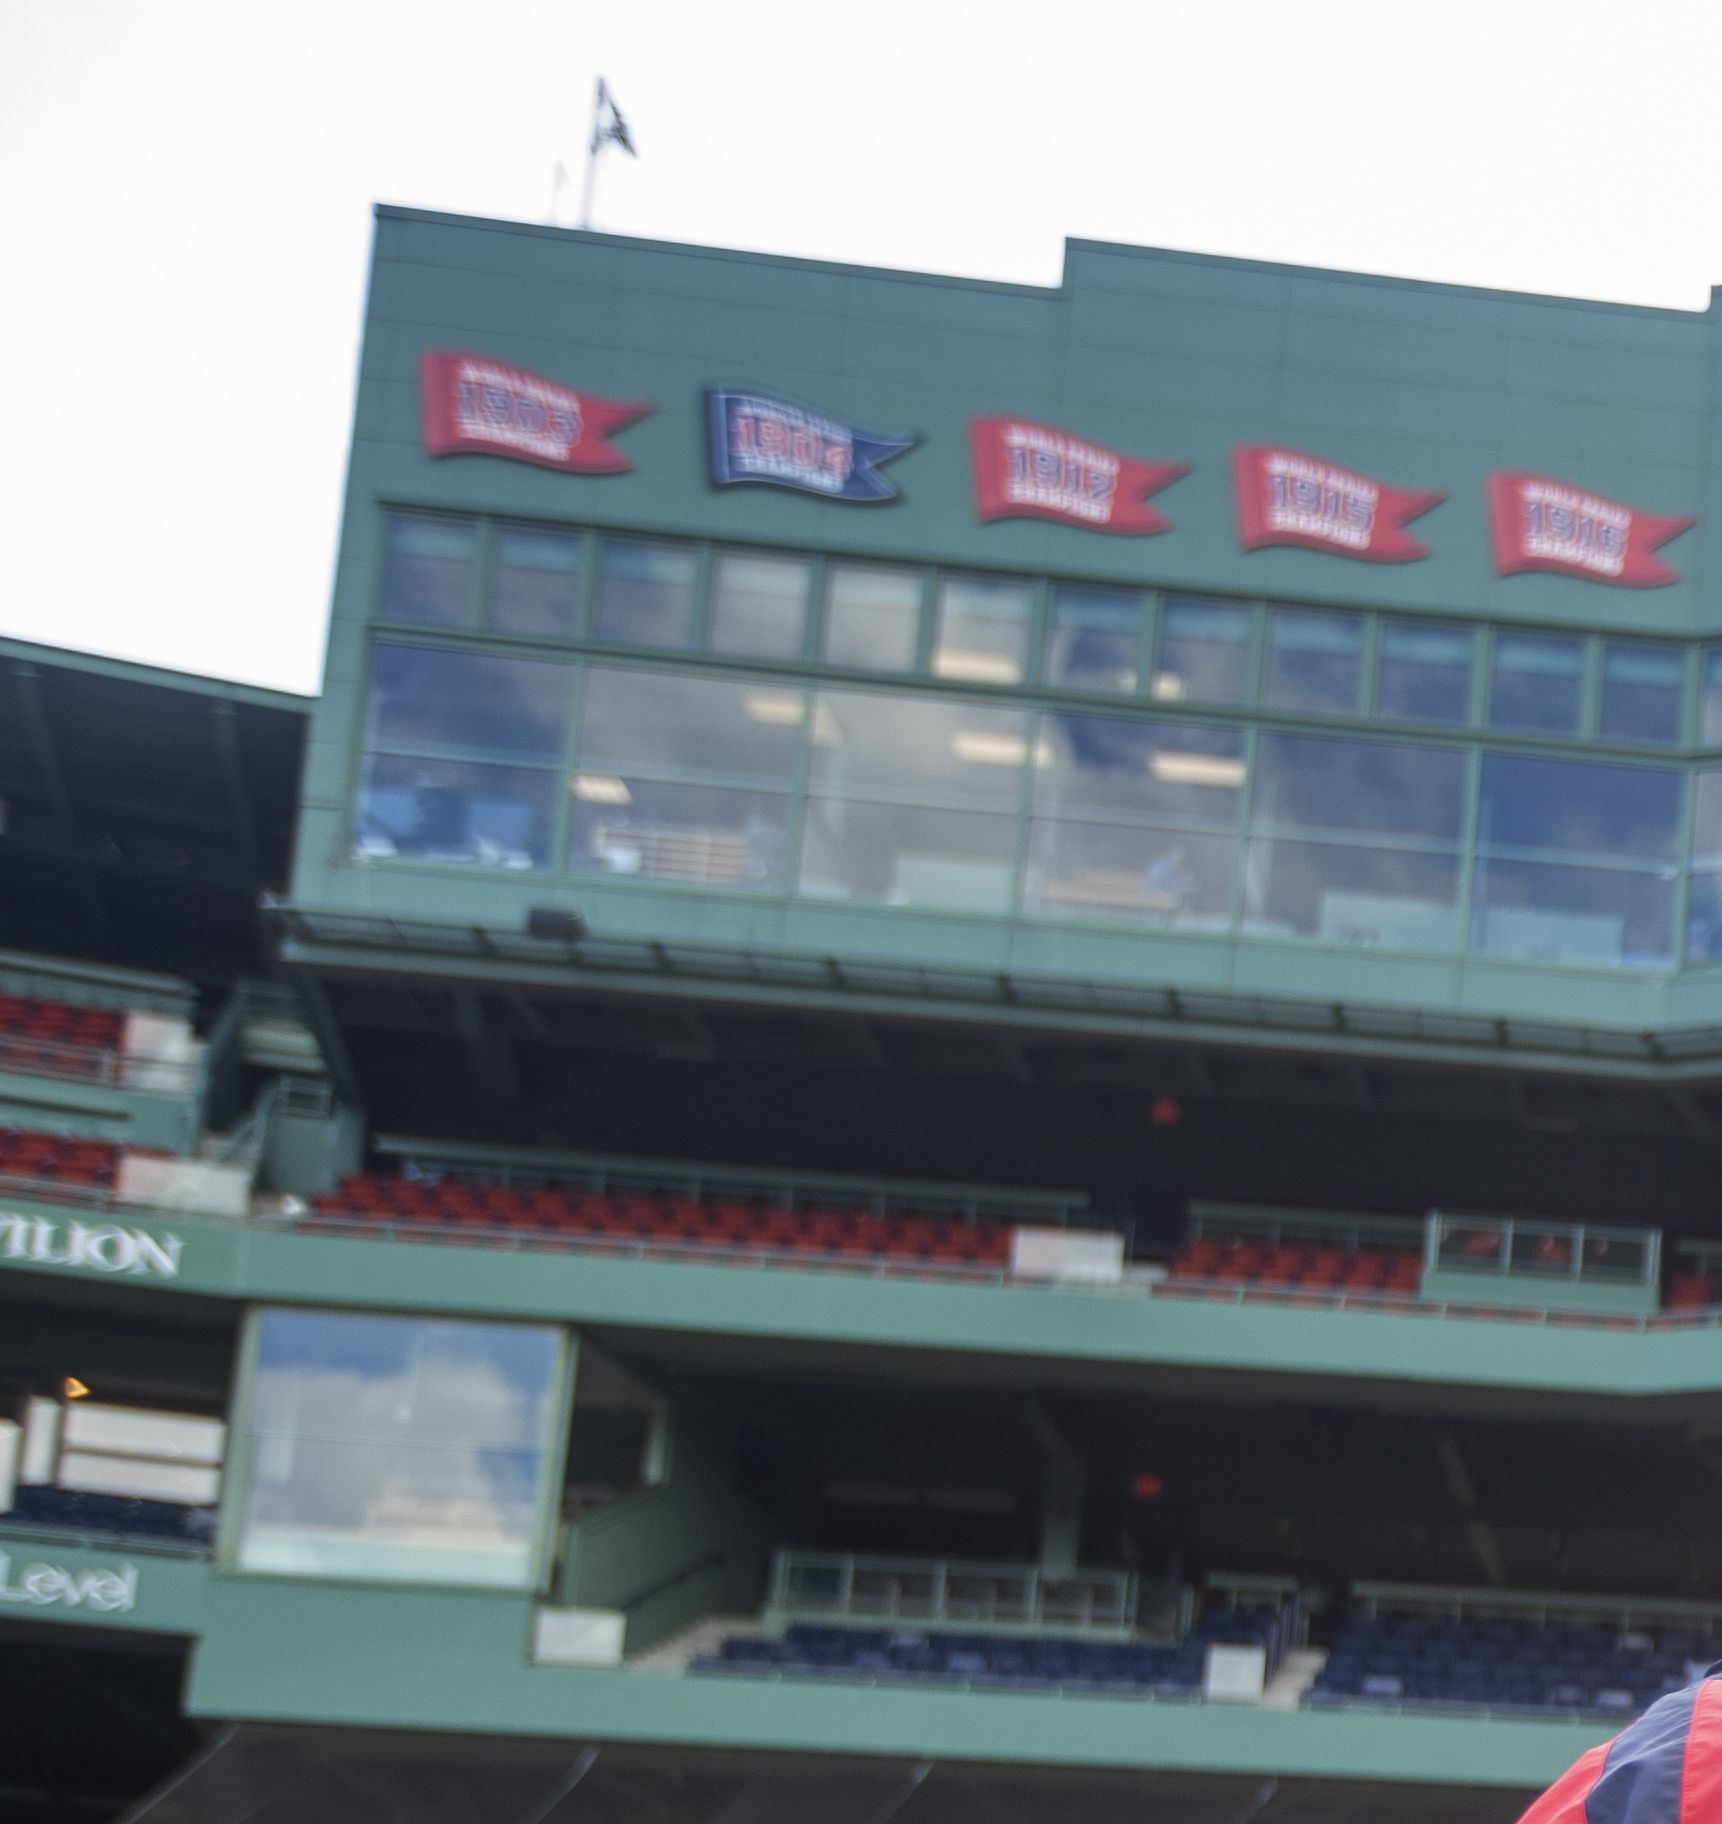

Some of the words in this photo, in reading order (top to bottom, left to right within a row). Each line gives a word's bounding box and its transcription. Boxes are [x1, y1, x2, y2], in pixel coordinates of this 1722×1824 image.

[455, 379, 582, 448] 1903
[1008, 447, 1116, 502] 1912
[1271, 475, 1373, 534] 1915
